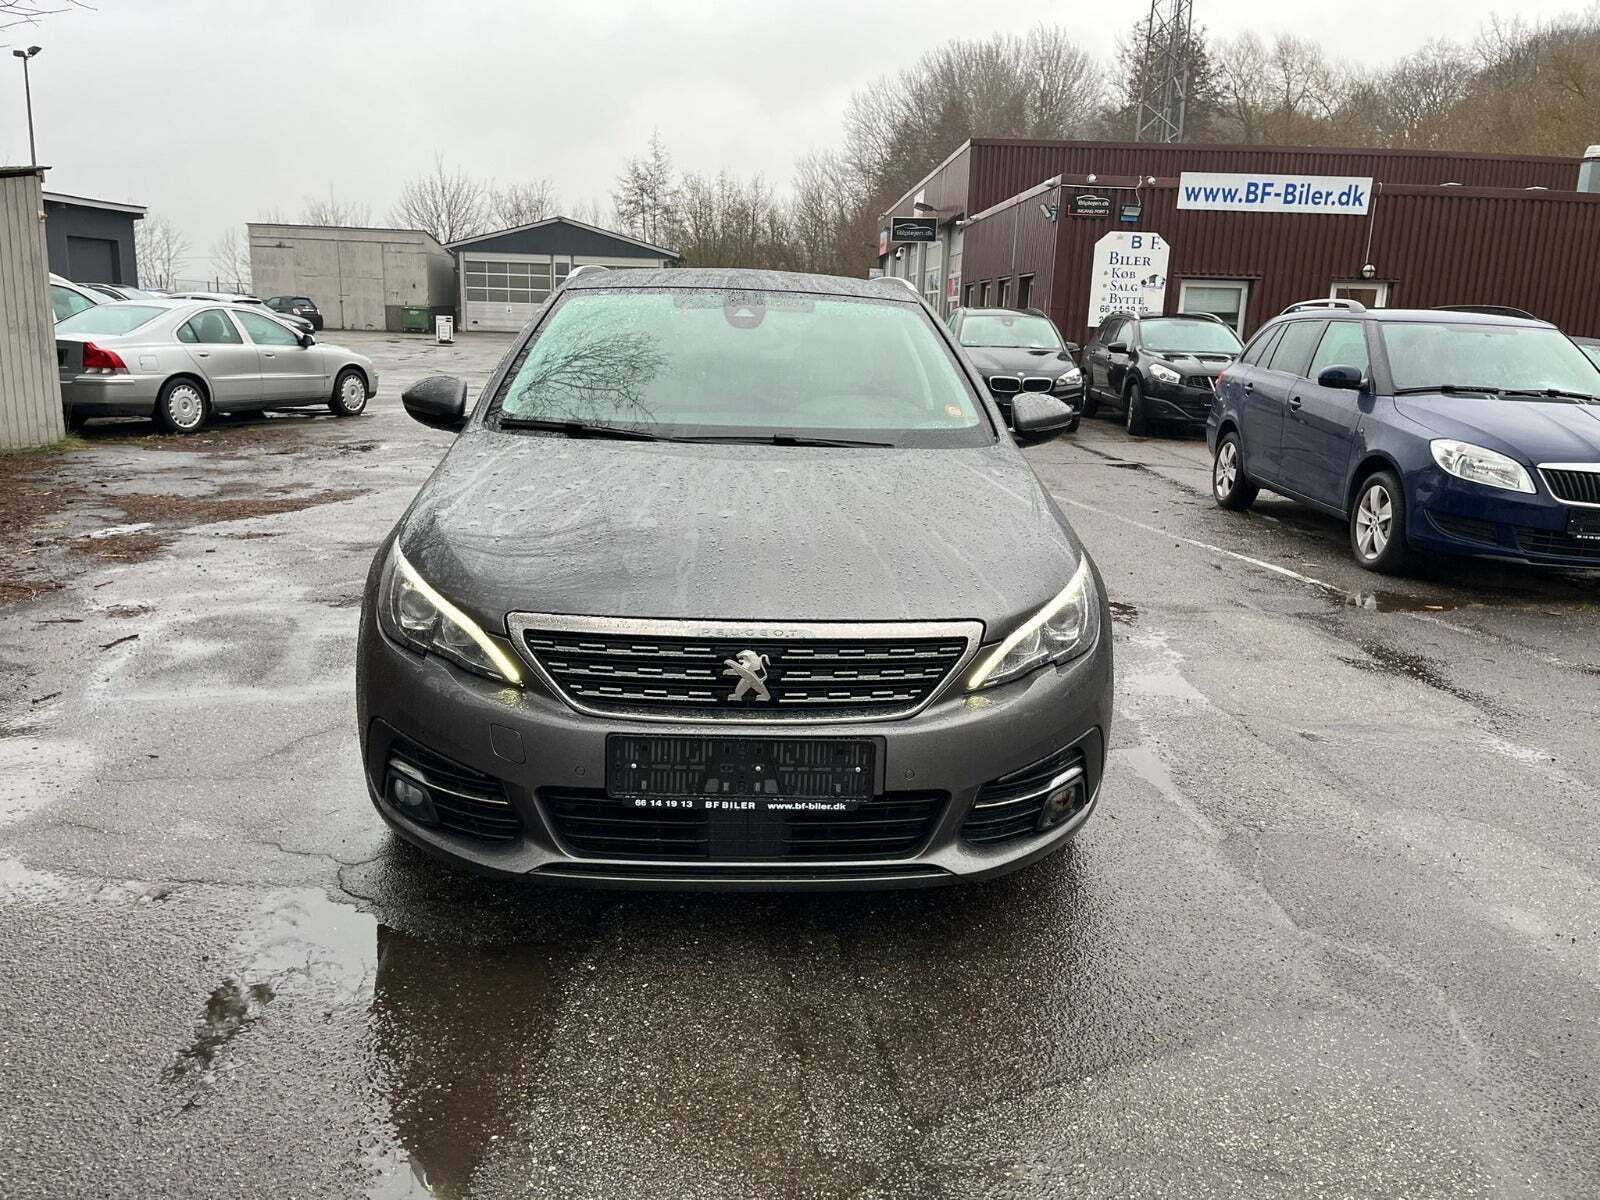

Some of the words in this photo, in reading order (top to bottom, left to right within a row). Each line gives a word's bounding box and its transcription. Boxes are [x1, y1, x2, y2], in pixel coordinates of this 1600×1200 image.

[1184, 181, 1365, 207] www.BF-Biler.dk
[1131, 235, 1142, 249] B
[1099, 304, 1110, 313] 66
[634, 799, 647, 807] 66
[650, 799, 662, 807] 14
[665, 800, 678, 808] 19
[680, 800, 693, 808] 13
[705, 801, 720, 809] BF
[721, 801, 756, 810] BILER
[767, 802, 847, 811] www.bf-biler.dk
